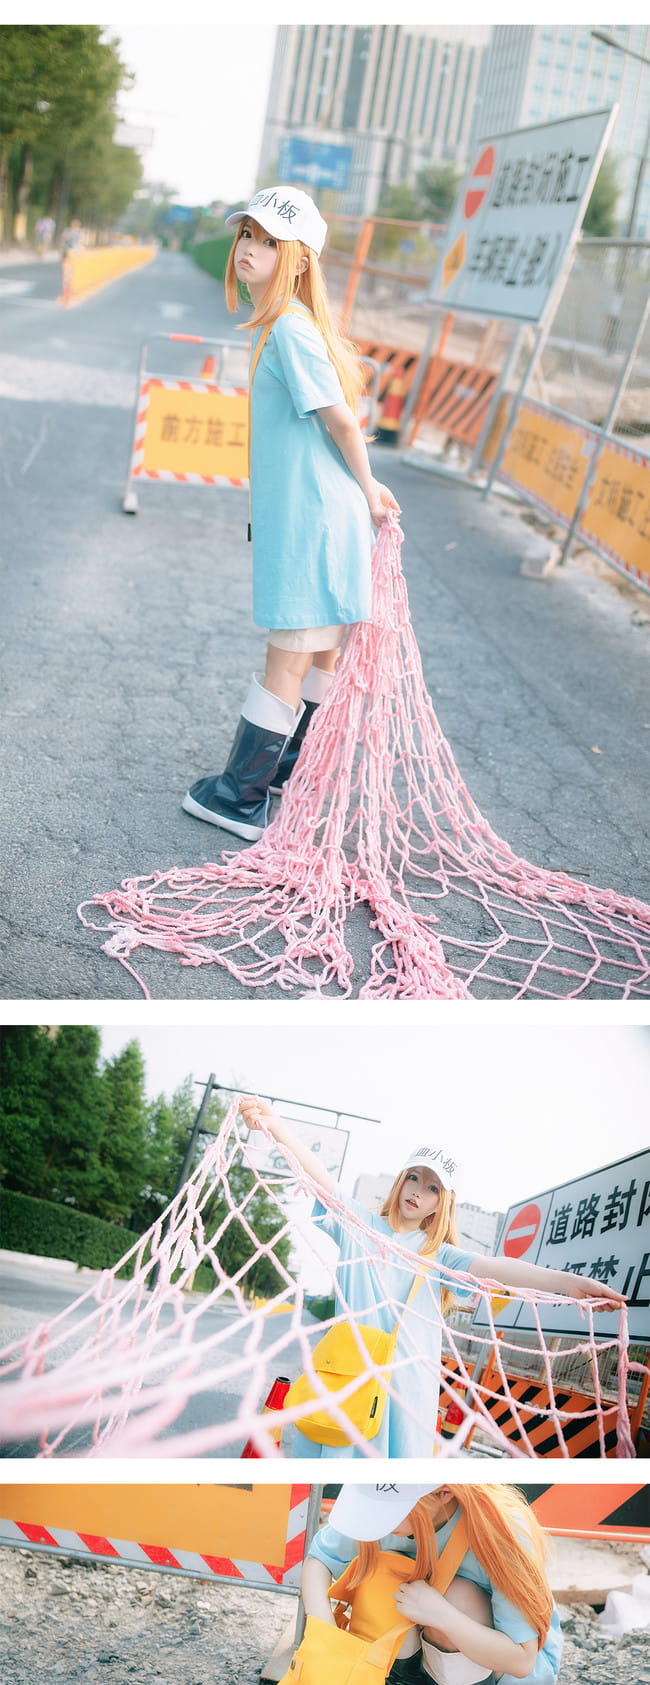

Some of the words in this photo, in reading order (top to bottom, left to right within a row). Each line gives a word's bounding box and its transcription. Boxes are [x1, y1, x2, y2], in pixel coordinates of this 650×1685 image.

[161, 413, 246, 449] 前方施工
[415, 1146, 459, 1177] 血小板
[539, 1253, 650, 1307] 禁止
